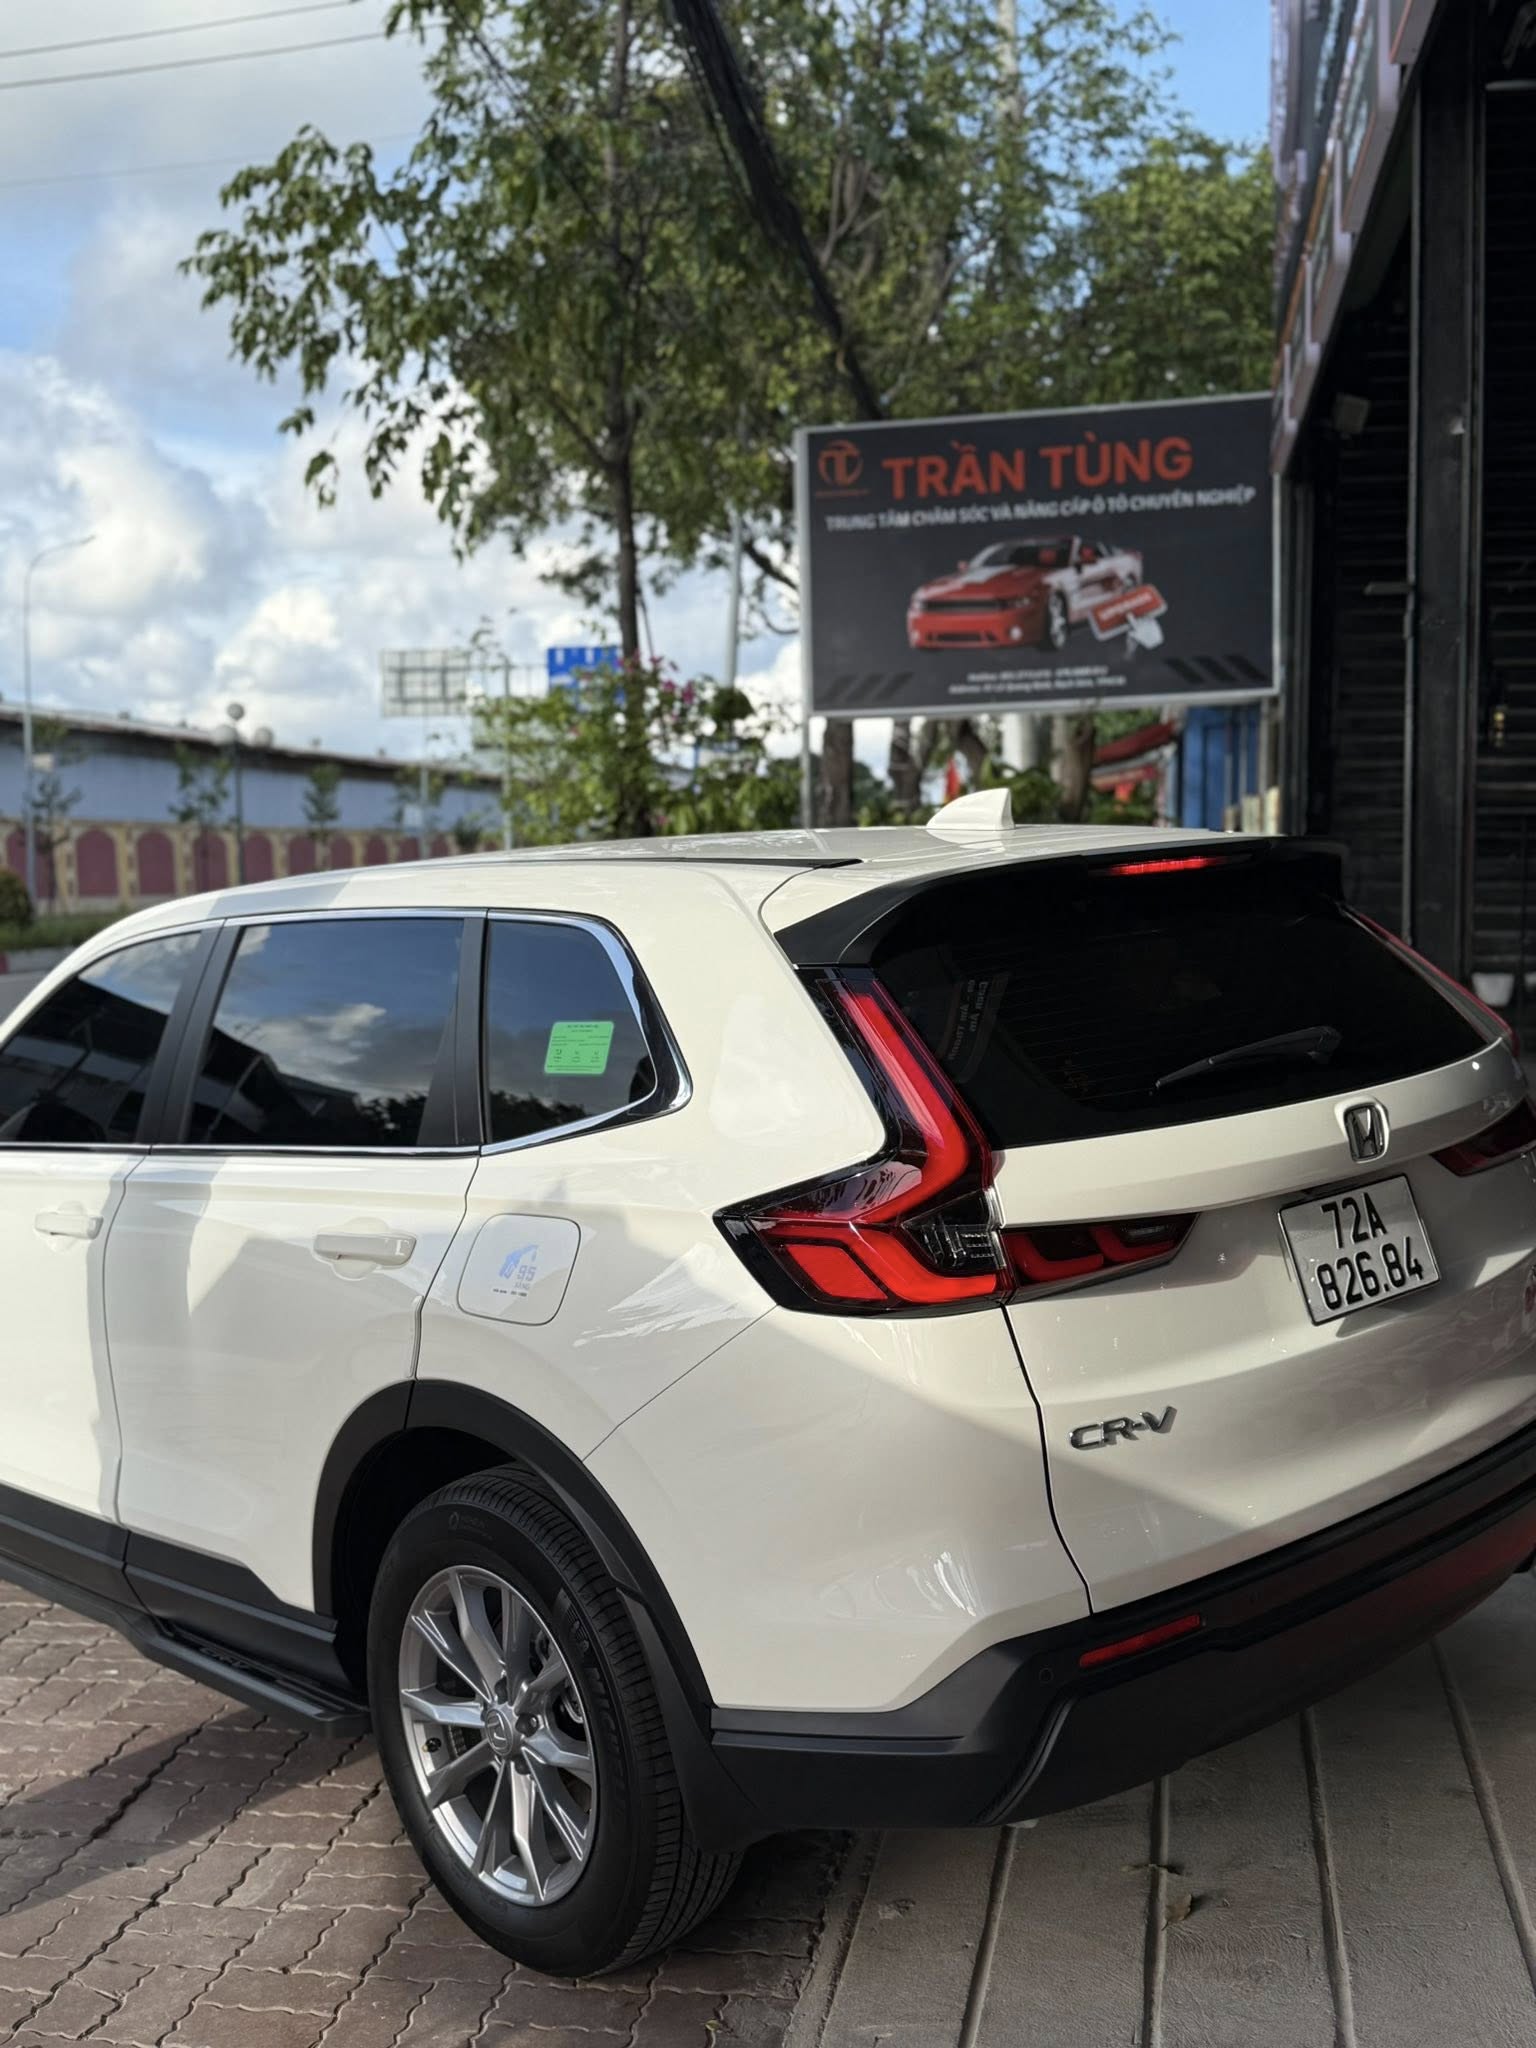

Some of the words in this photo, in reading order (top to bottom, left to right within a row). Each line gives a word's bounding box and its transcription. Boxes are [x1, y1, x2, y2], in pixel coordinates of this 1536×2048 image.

[881, 440, 1026, 500] TRẦN
[1039, 431, 1194, 489] TÙNG
[825, 512, 877, 532] TRUNG
[1107, 492, 1129, 514] TÔ
[1320, 1192, 1387, 1249] 72A
[1316, 1236, 1424, 1310] 826.84
[1069, 1406, 1178, 1451] CR-V
